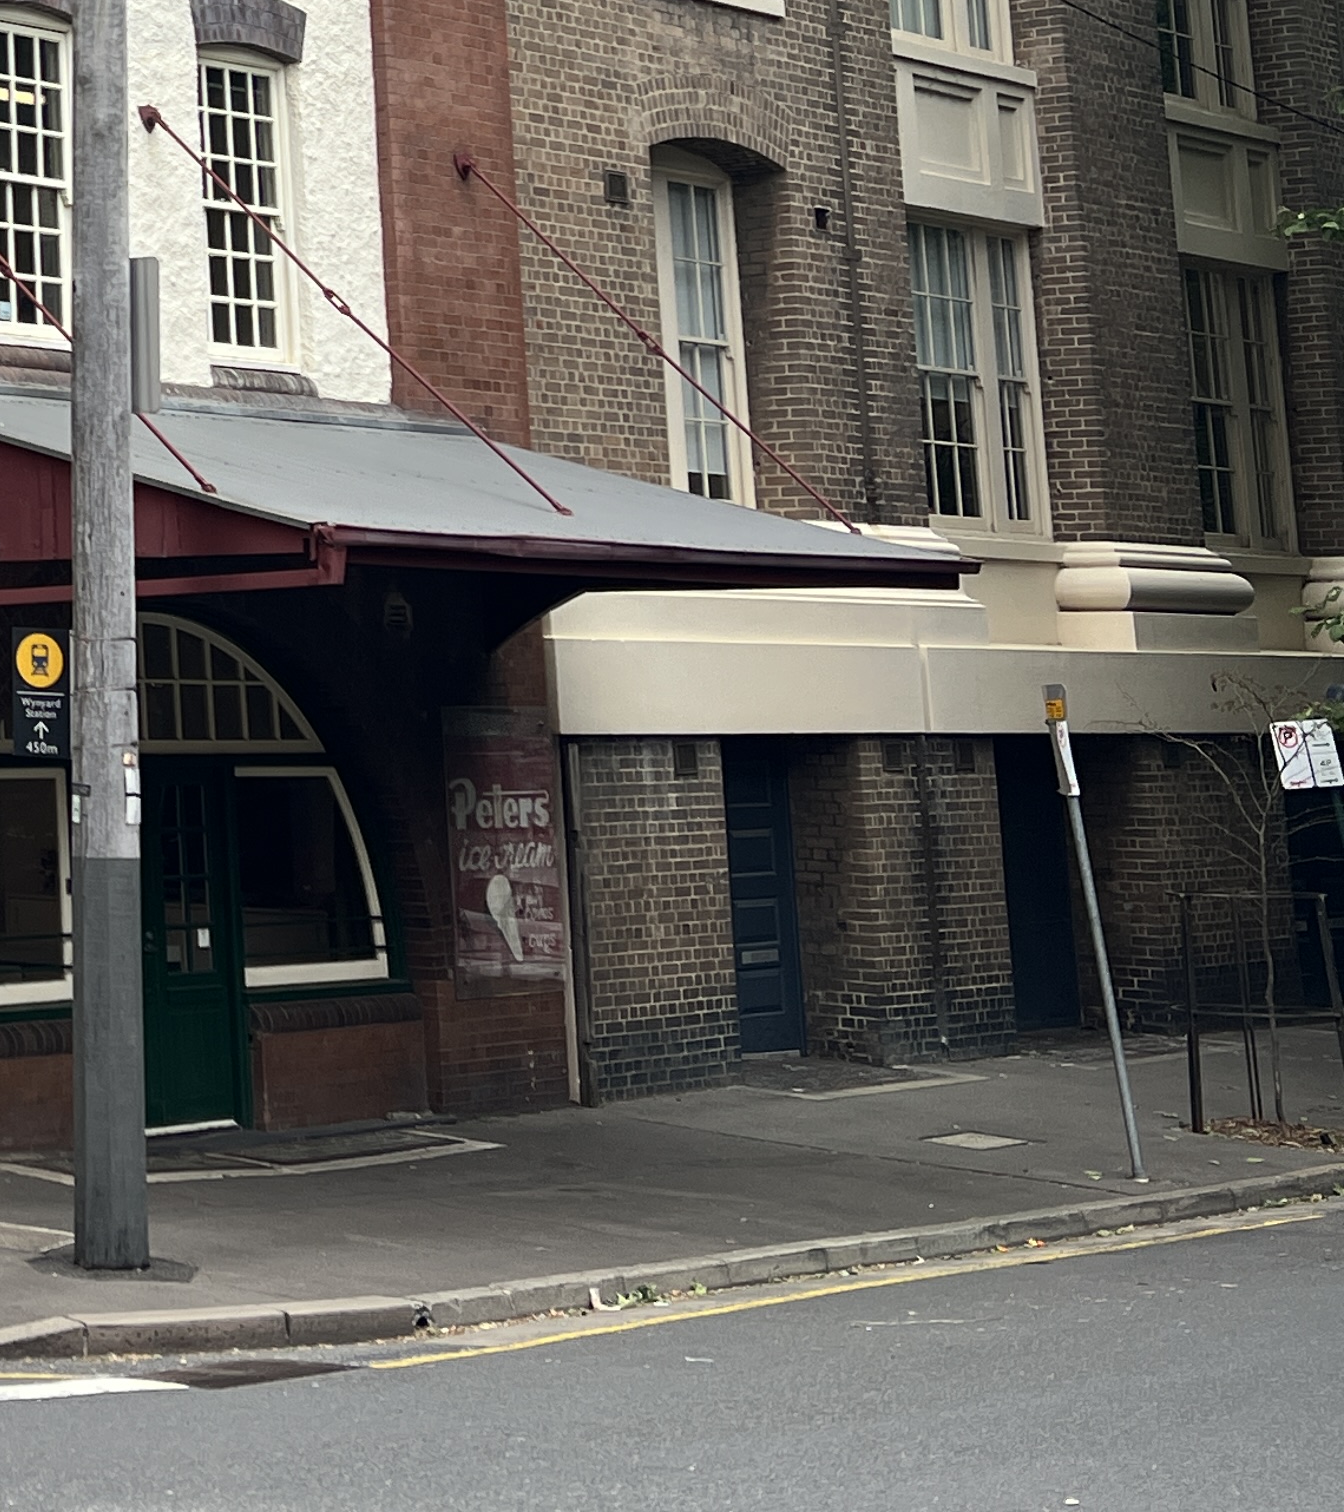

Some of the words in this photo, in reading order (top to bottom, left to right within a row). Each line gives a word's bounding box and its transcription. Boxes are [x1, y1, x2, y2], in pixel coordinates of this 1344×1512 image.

[20, 697, 61, 711] Wynyard
[24, 707, 57, 719] Station
[25, 741, 59, 755] 450m
[449, 778, 550, 829] Peters
